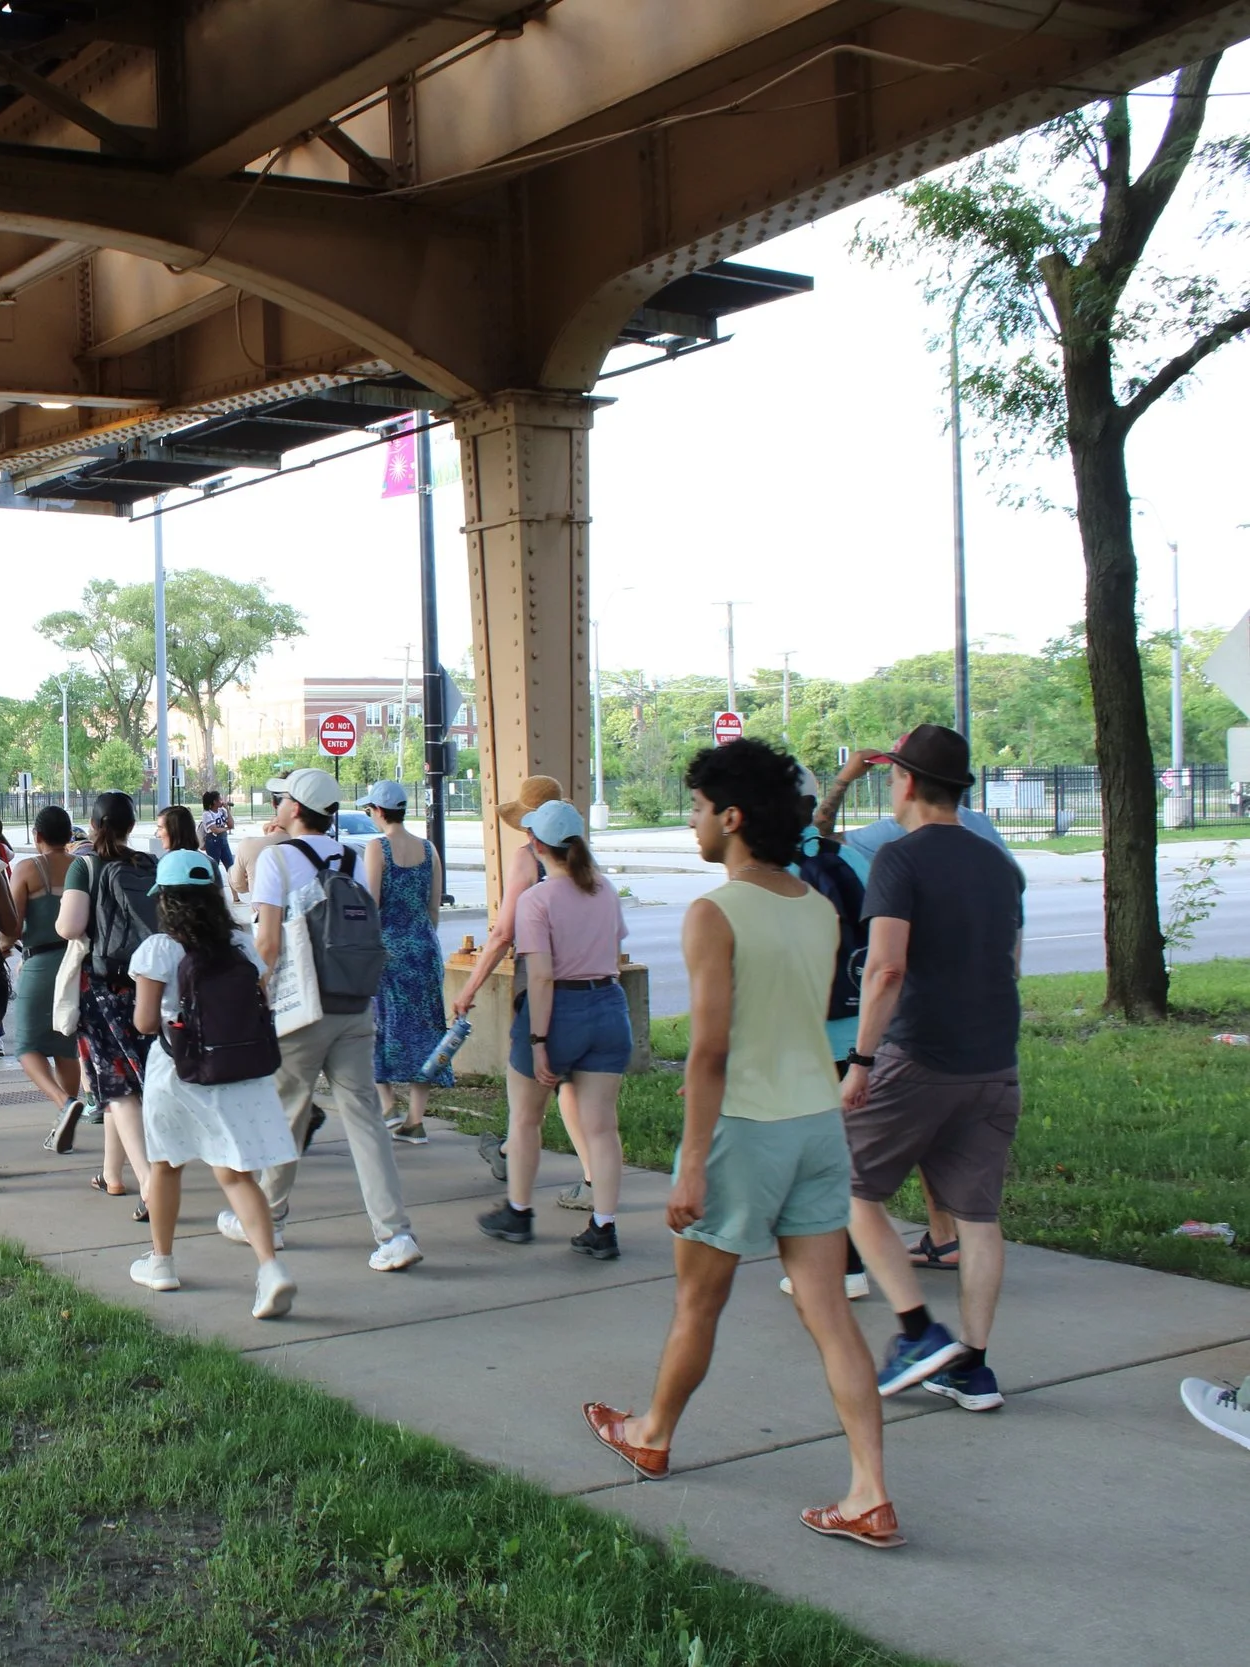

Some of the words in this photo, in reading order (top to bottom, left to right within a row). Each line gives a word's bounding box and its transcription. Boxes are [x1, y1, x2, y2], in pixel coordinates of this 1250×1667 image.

[325, 722, 335, 730] DO
[337, 722, 351, 730] NOT
[327, 740, 348, 748] ENTER
